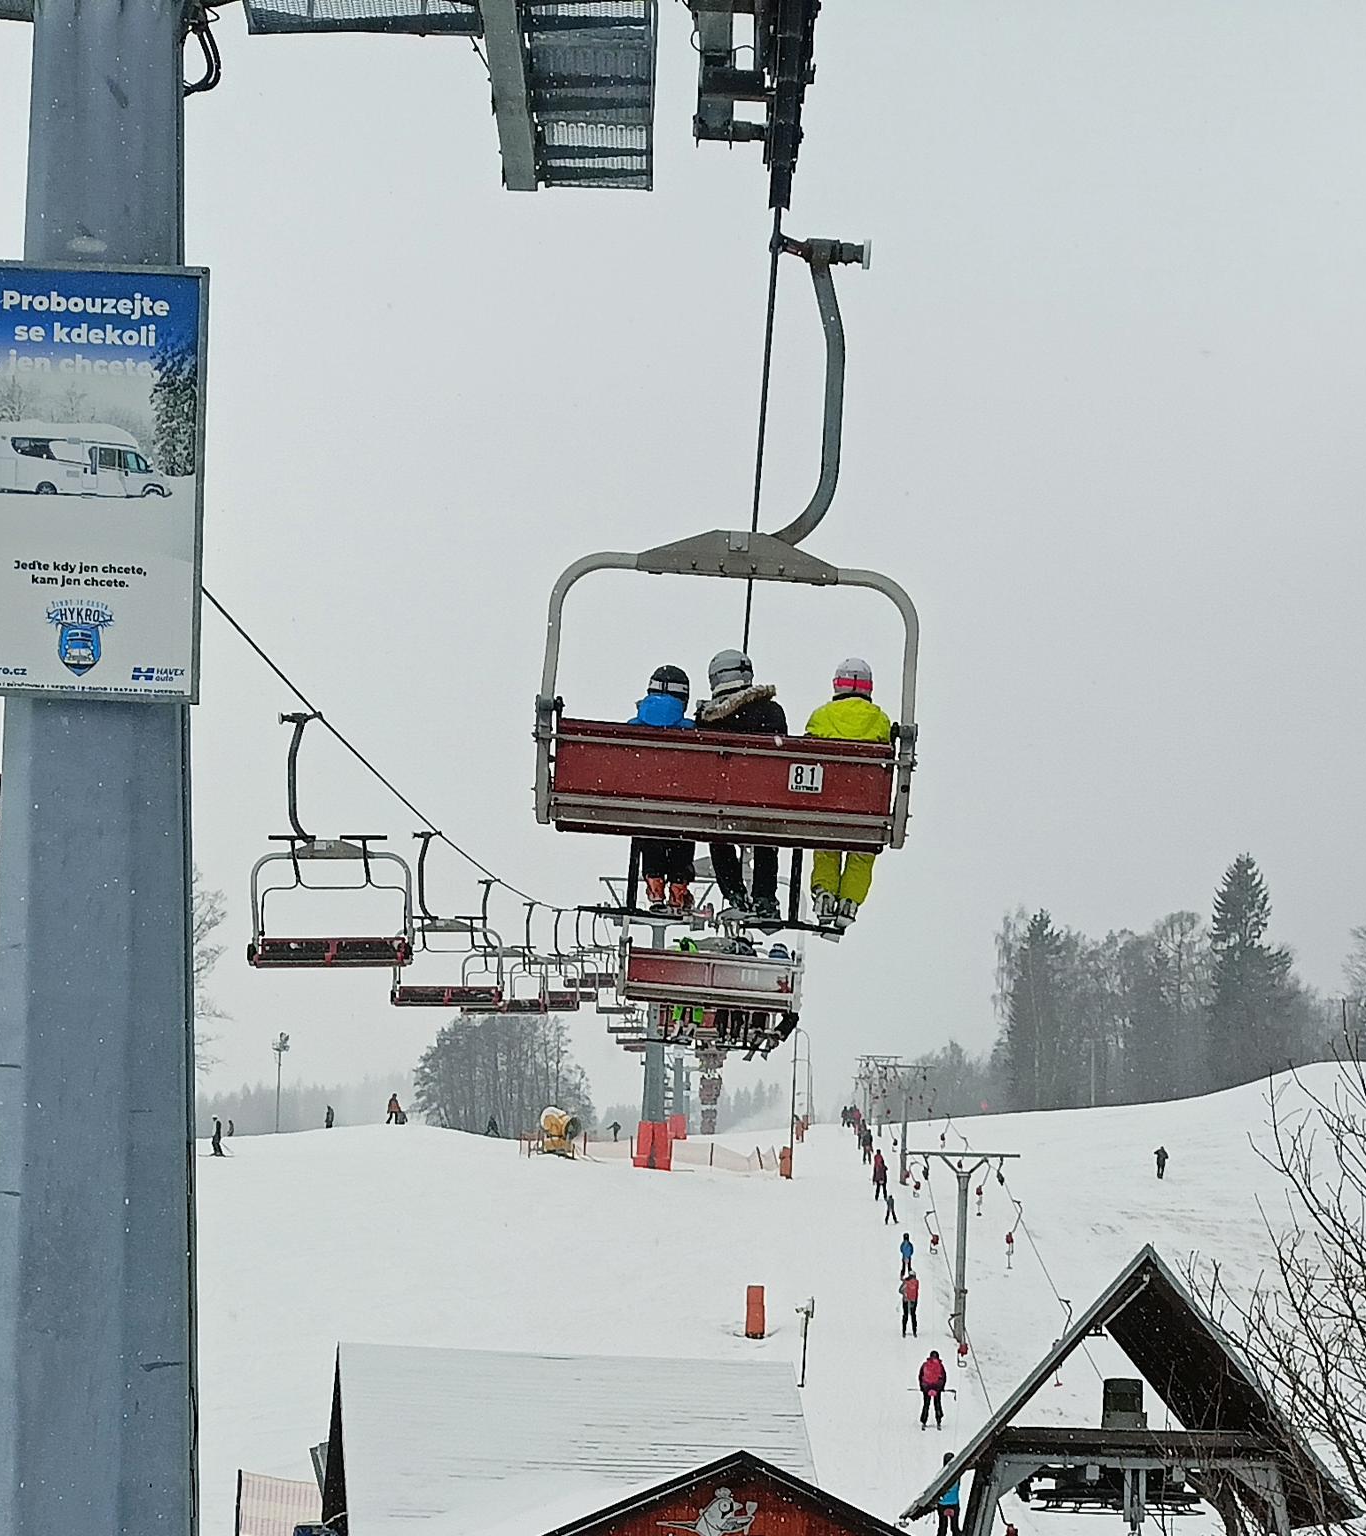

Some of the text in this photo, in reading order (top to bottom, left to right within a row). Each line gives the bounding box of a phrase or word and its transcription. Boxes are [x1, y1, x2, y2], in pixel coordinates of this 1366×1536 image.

[2, 290, 170, 320] Probouzejte
[14, 322, 156, 347] se kdekoli
[7, 349, 51, 376] jen
[14, 560, 147, 576] Jeďte kdy jen chcete,
[31, 574, 129, 588] kam jen chcete.
[59, 607, 100, 624] HYKRO
[156, 668, 185, 676] HAVEX
[795, 766, 815, 785] 81
